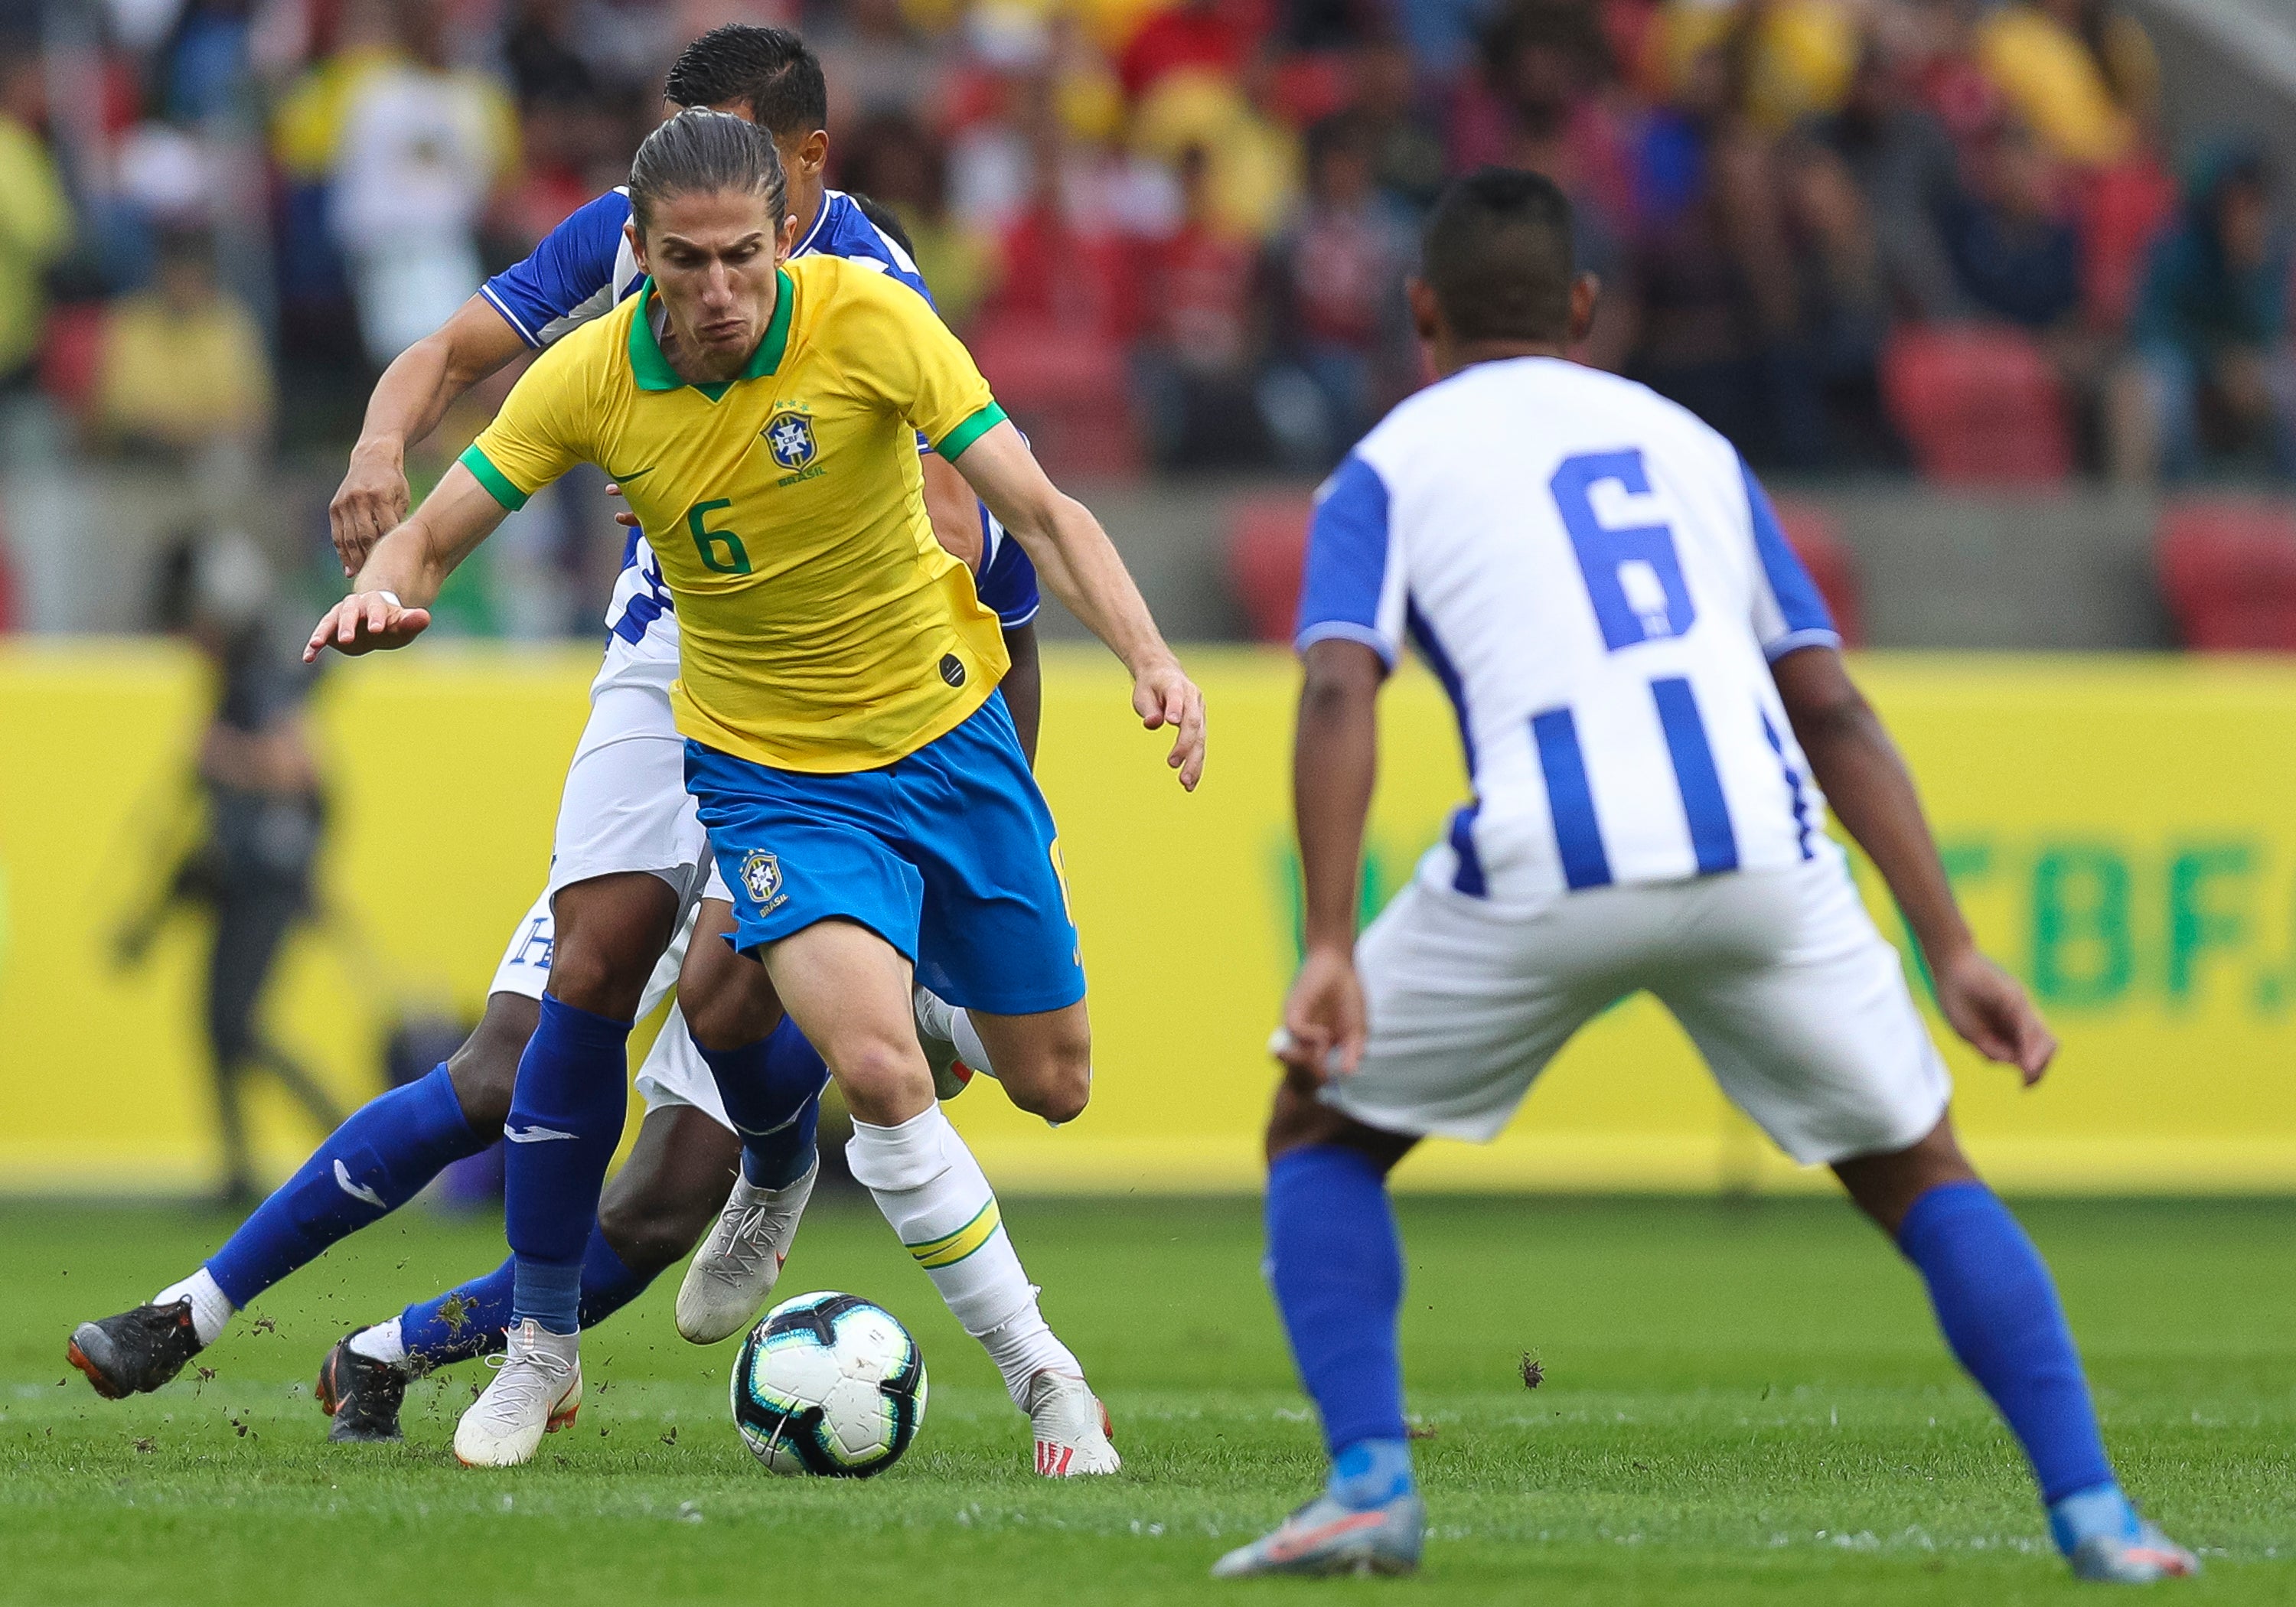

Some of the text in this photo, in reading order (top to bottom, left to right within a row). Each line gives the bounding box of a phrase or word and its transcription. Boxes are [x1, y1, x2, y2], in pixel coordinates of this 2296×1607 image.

[777, 466, 827, 487] BRASIL
[687, 497, 752, 575] 6
[1551, 447, 1696, 650] 6
[759, 893, 789, 918] BRASIL
